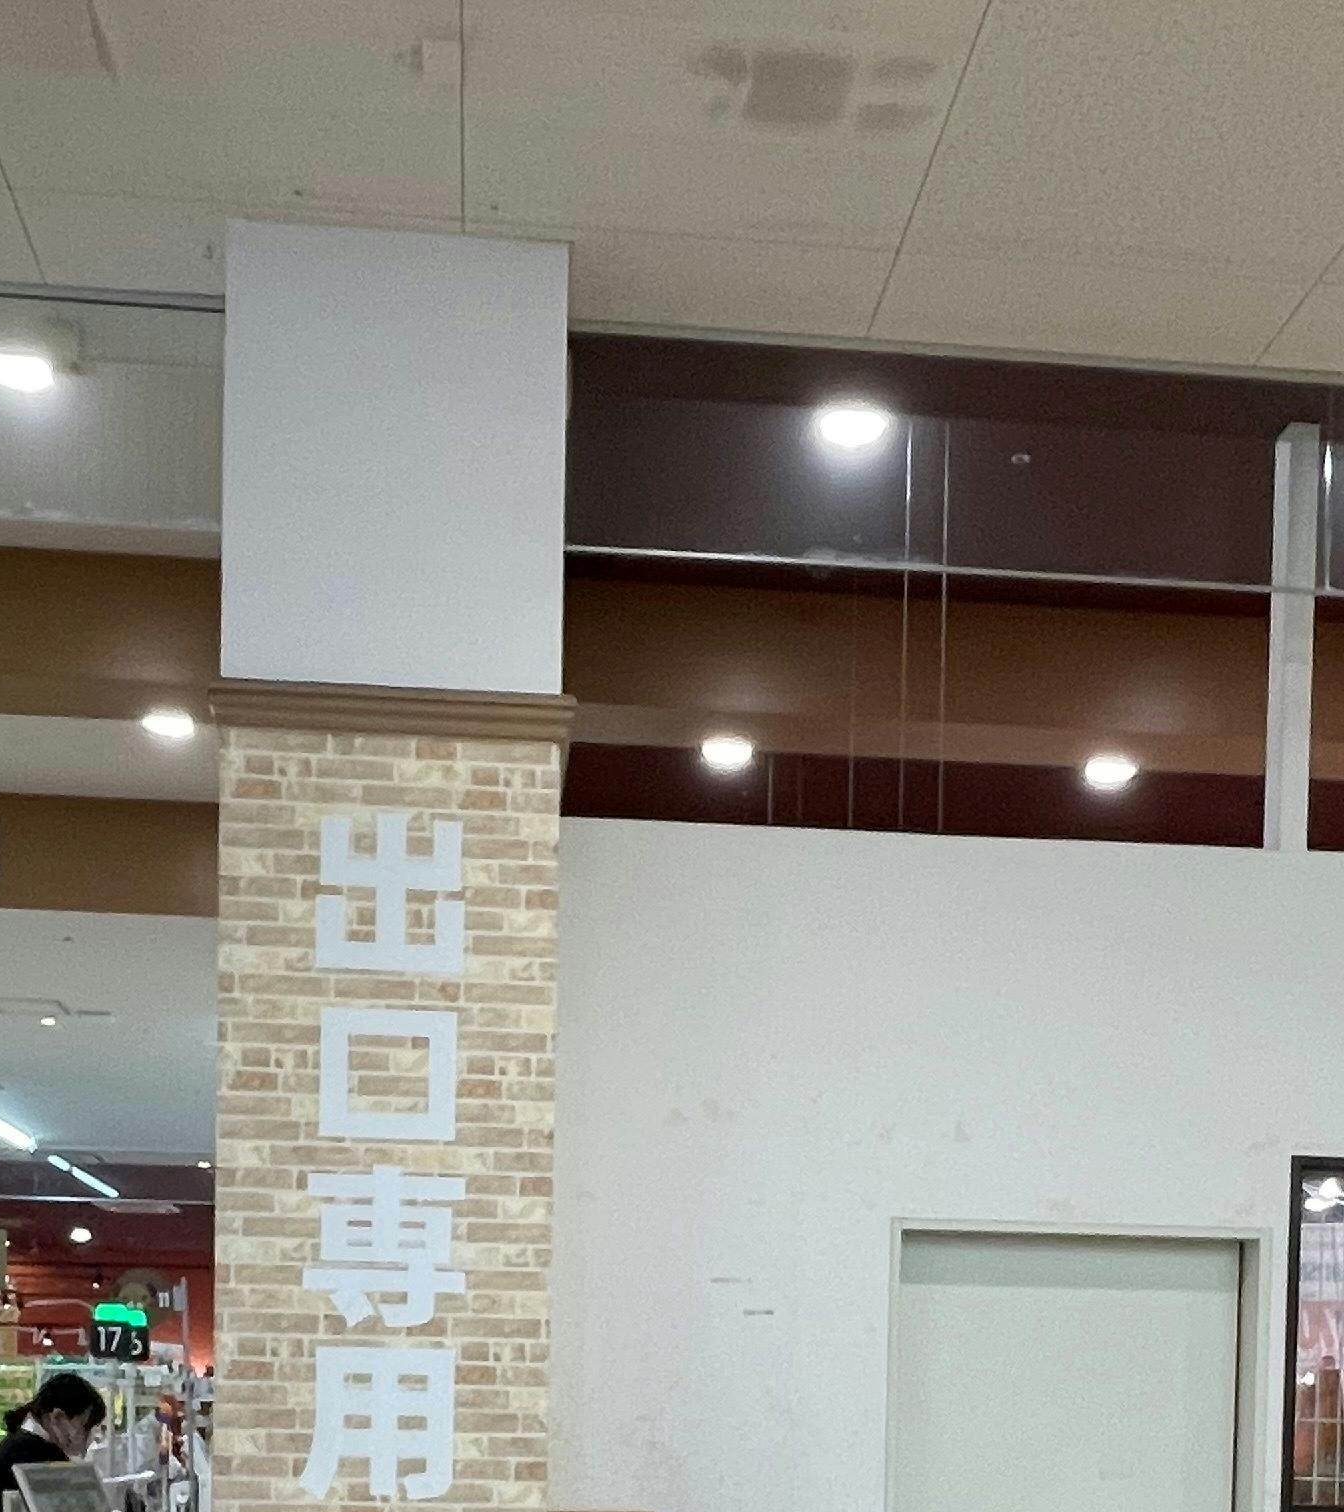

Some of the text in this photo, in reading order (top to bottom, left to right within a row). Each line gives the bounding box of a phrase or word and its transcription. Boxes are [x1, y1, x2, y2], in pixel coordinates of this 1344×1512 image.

[298, 810, 466, 1501] 出口専用
[97, 1326, 122, 1352] 17
